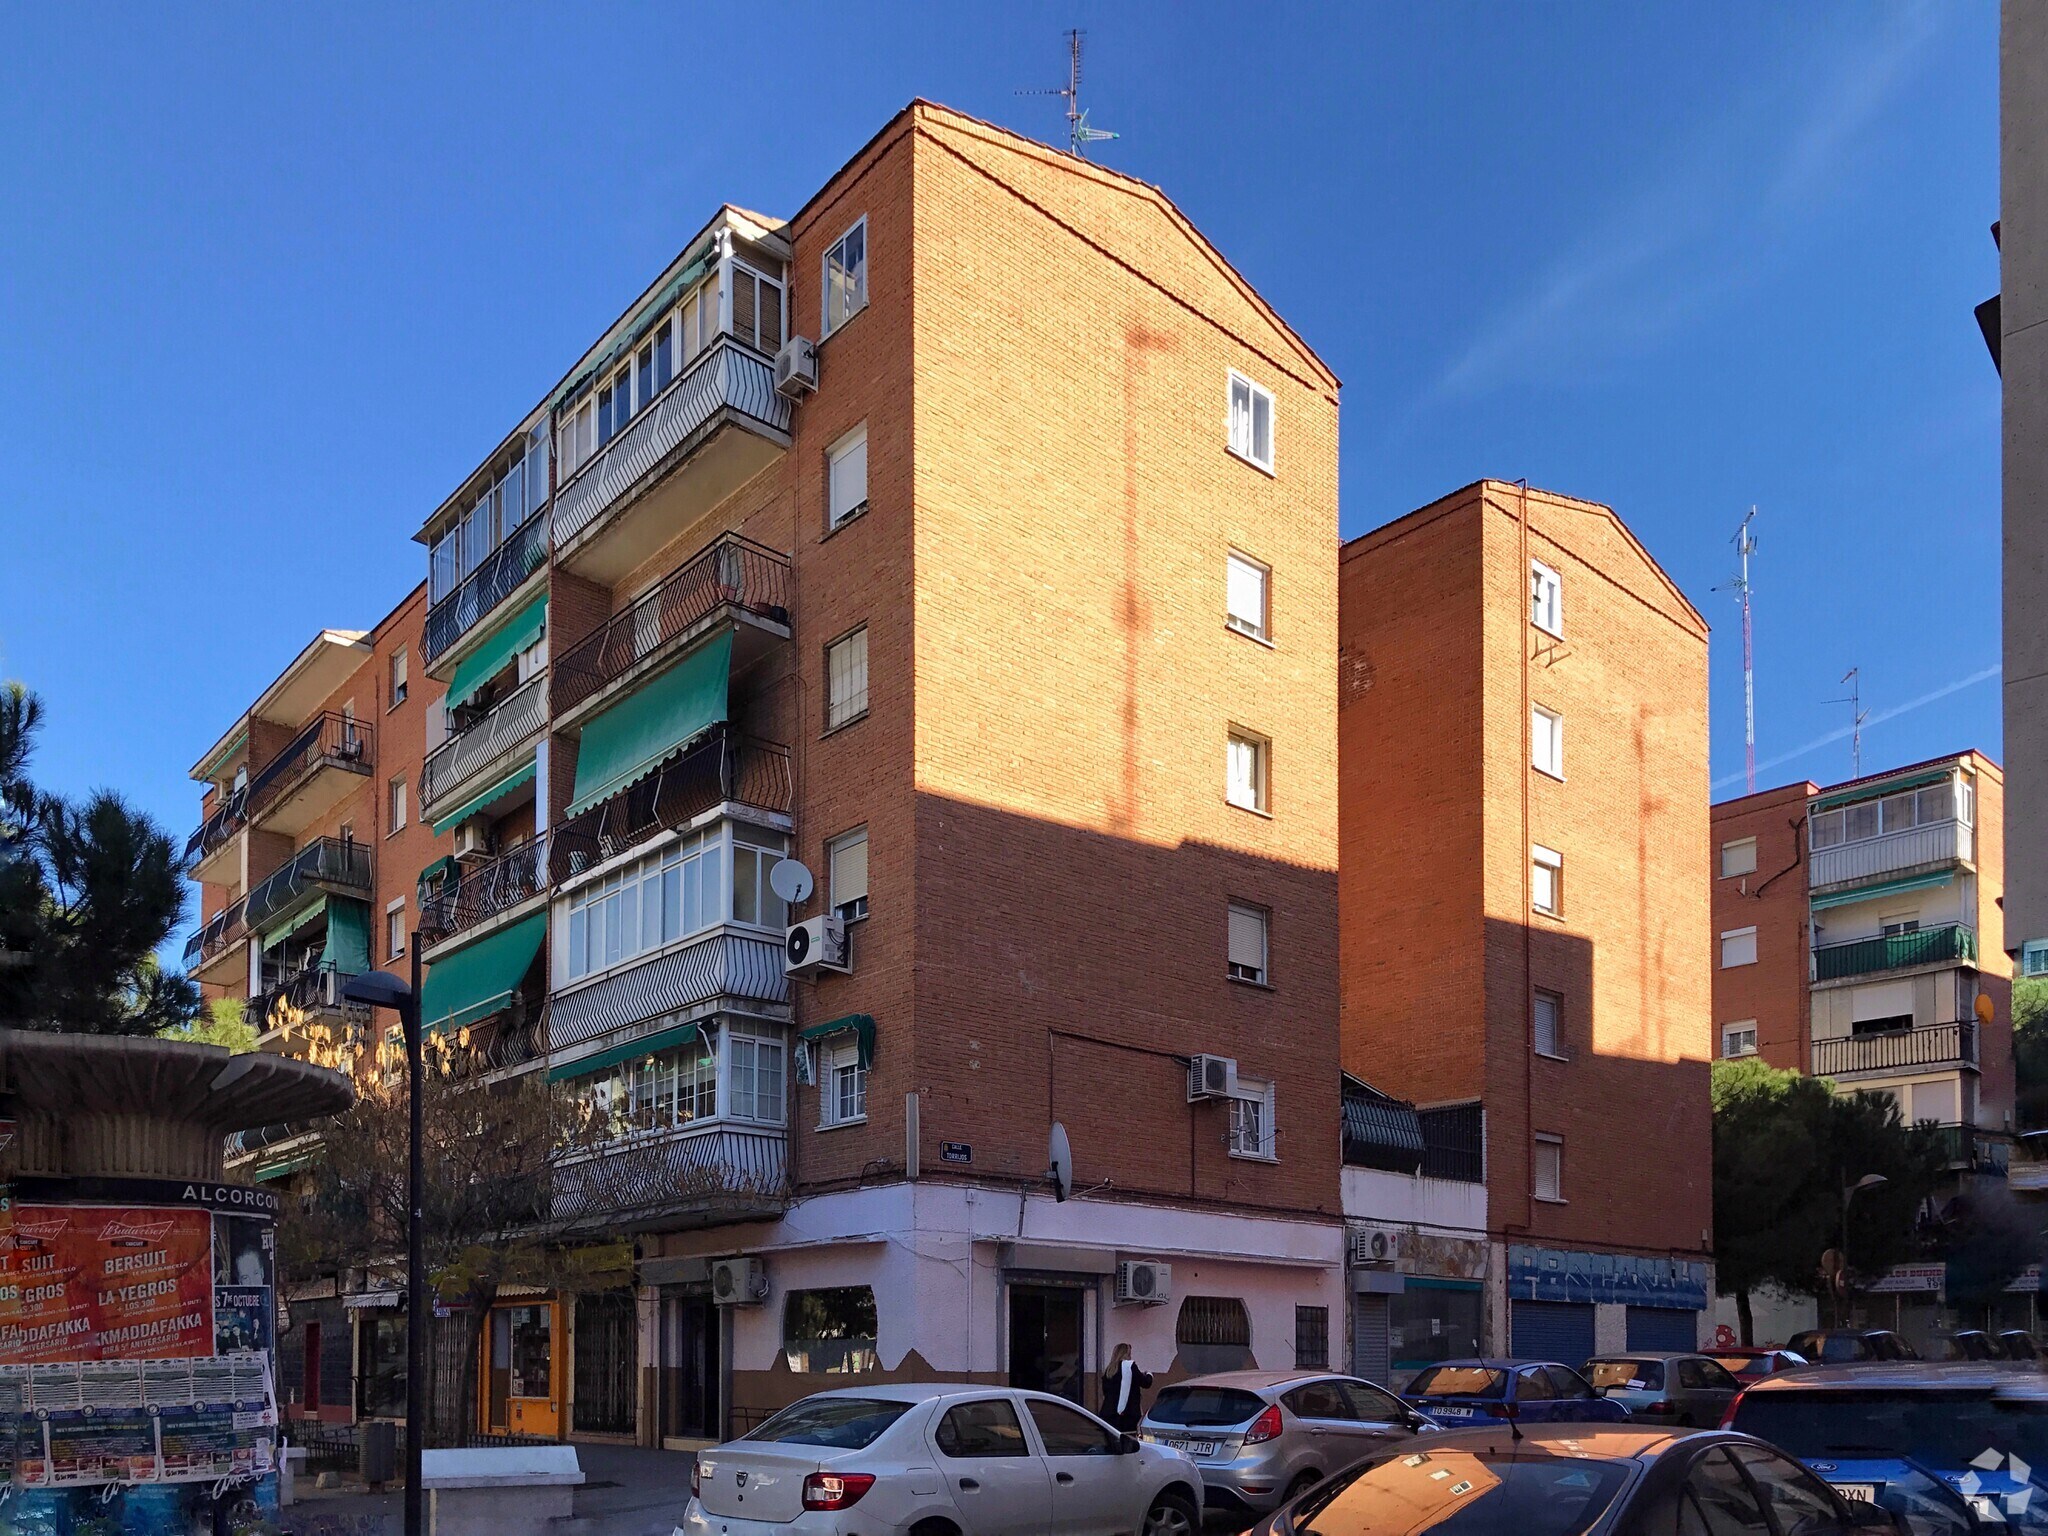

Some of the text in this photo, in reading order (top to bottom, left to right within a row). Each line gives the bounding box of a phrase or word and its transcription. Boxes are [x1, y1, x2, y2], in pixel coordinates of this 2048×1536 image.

[182, 1185, 279, 1210] ALCORCON
[105, 1225, 167, 1237] Budweiser
[104, 1250, 168, 1275] BERSUIT
[98, 1278, 177, 1307] LA YEGROS
[221, 1291, 228, 1308] 7
[233, 1294, 260, 1308] OCTUBRE
[130, 1332, 181, 1349] ANIVERSARIO
[1168, 1440, 1189, 1451] 0671
[1194, 1442, 1212, 1453] JTR
